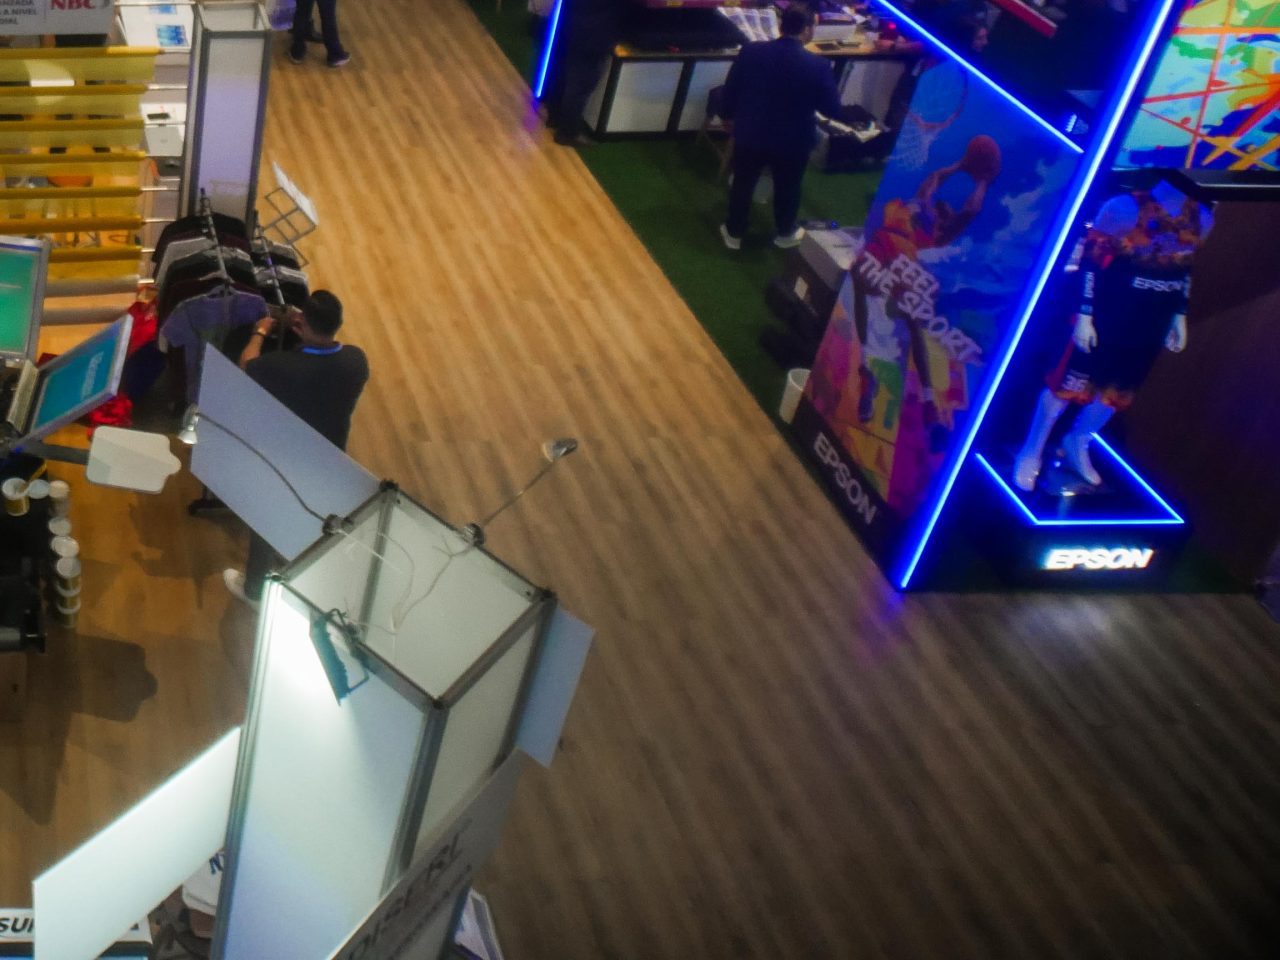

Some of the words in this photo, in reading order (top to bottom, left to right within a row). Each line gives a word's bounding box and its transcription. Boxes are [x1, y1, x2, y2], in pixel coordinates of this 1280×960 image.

[860, 250, 900, 295] THE
[890, 253, 939, 304] FEEL
[1132, 276, 1185, 292] EPSON
[897, 291, 985, 367] SPORT
[813, 431, 878, 525] EPSON
[1044, 548, 1154, 570] EPSON
